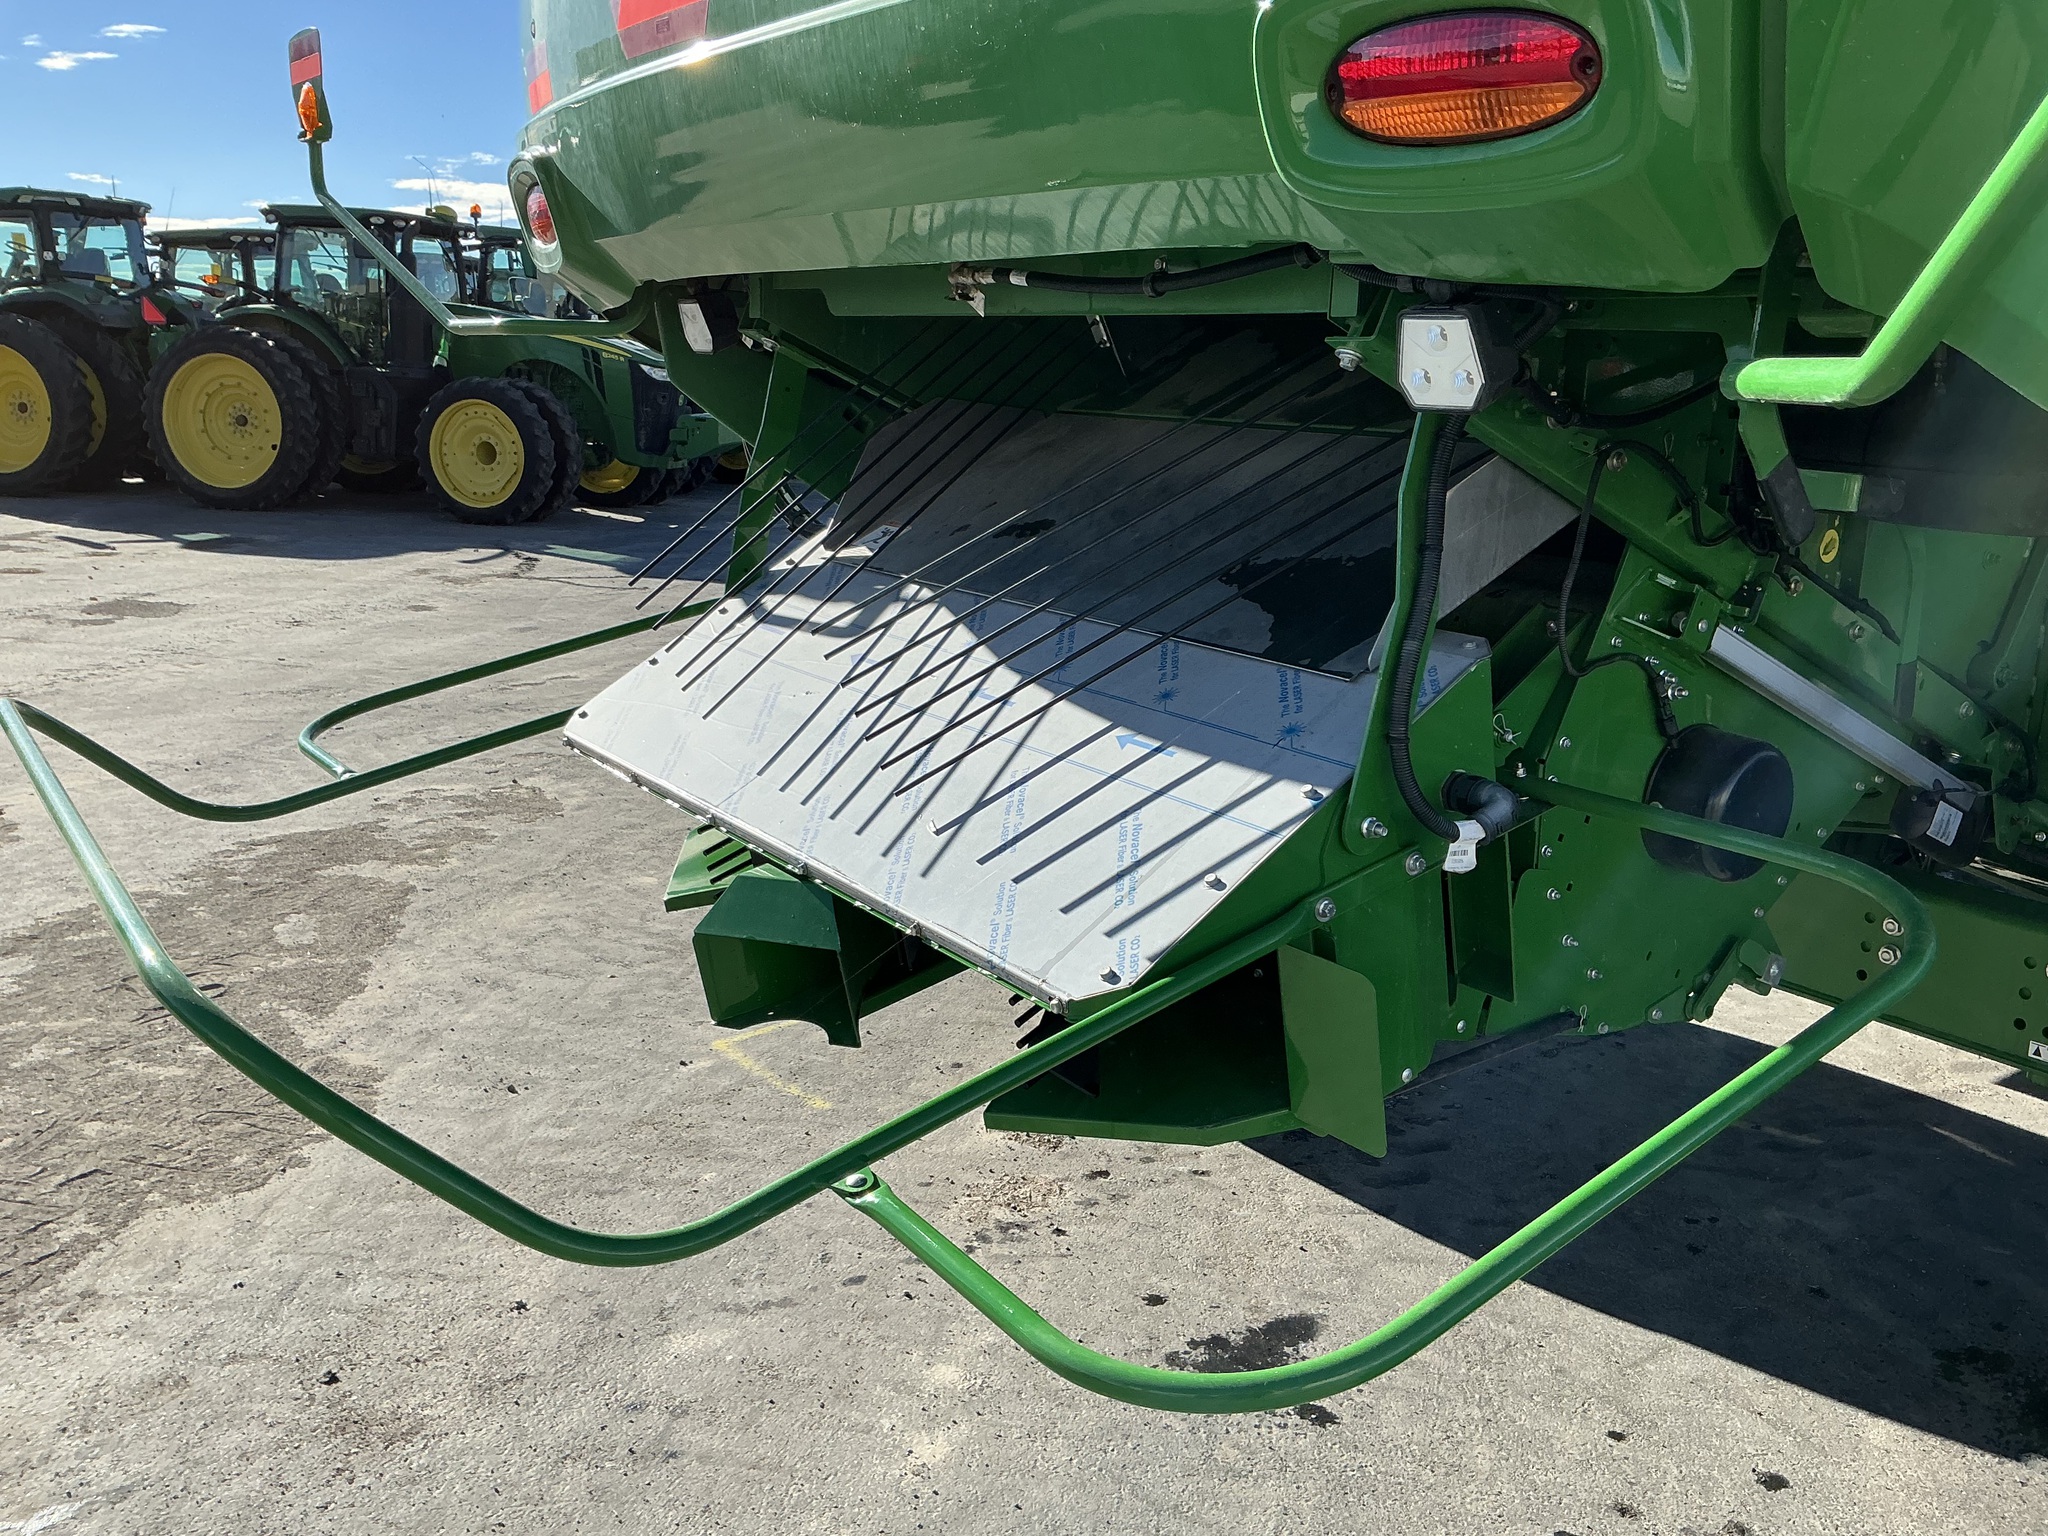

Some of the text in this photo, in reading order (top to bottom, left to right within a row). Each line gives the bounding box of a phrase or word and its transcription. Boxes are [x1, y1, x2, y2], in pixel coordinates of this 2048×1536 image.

[1171, 654, 1180, 672] LASER
[1159, 672, 1168, 684] The
[1170, 672, 1179, 680] for
[1294, 685, 1302, 704] LASER
[1281, 704, 1290, 718] The
[1294, 705, 1303, 714] for
[1119, 822, 1128, 844] LASER
[1118, 845, 1127, 864] Fiber
[1128, 870, 1138, 906] Solution
[994, 882, 1006, 916] Solution
[1006, 893, 1016, 917] LASER
[1002, 924, 1012, 942] Fiber
[1116, 938, 1126, 976] Solution
[1129, 952, 1140, 980] LASER
